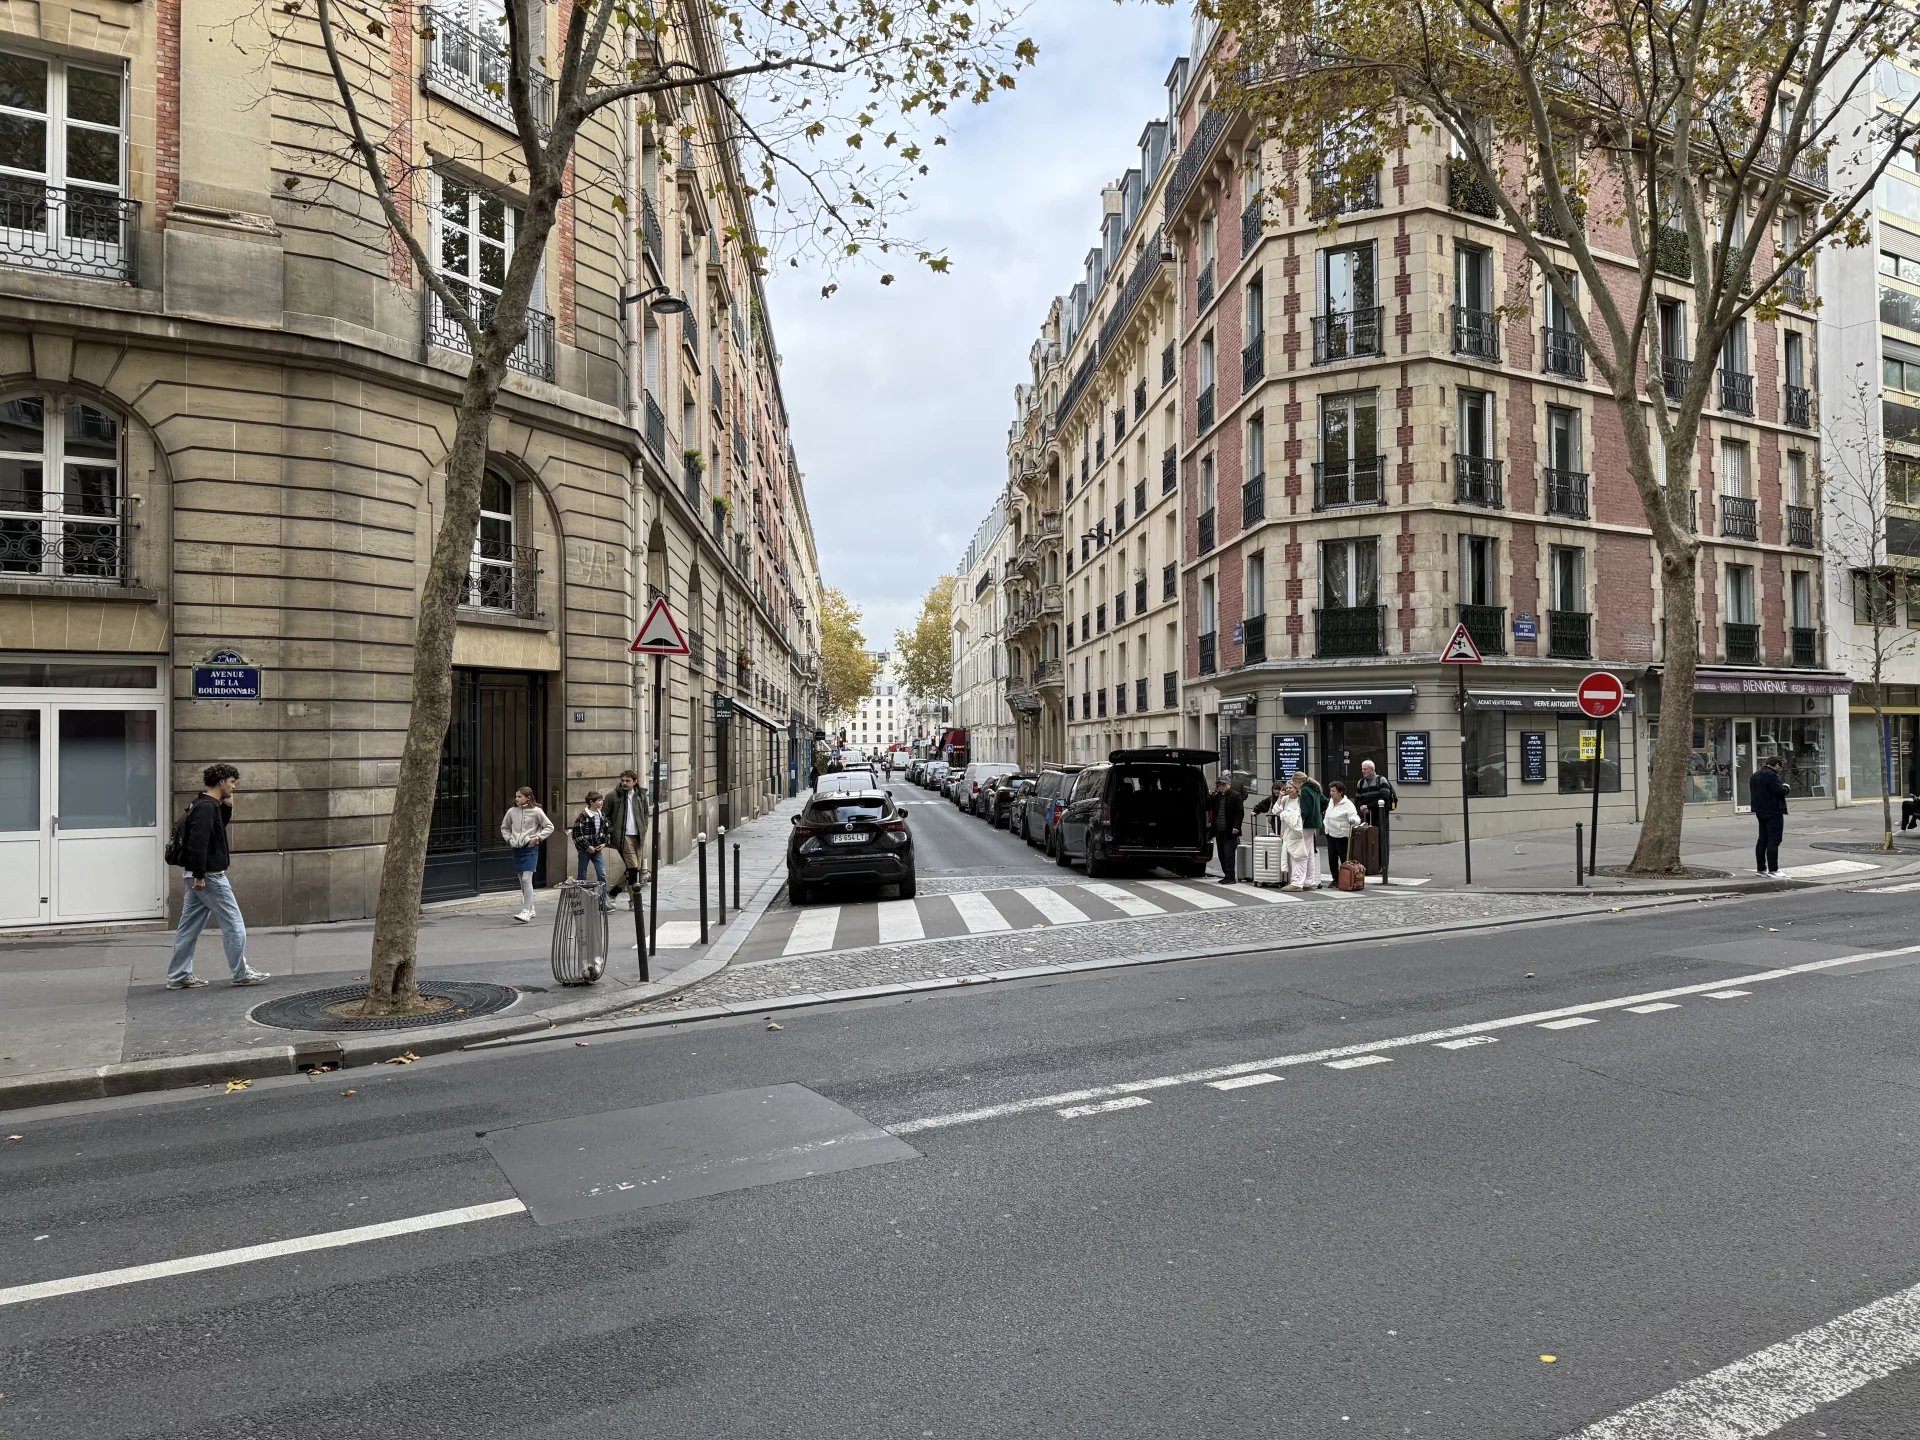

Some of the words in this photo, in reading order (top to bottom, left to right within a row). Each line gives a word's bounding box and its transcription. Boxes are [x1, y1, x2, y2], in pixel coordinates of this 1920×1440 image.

[1743, 679, 1788, 693] BIENVENUE
[198, 687, 256, 695] BOURDONNAIS
[576, 712, 584, 721] 91
